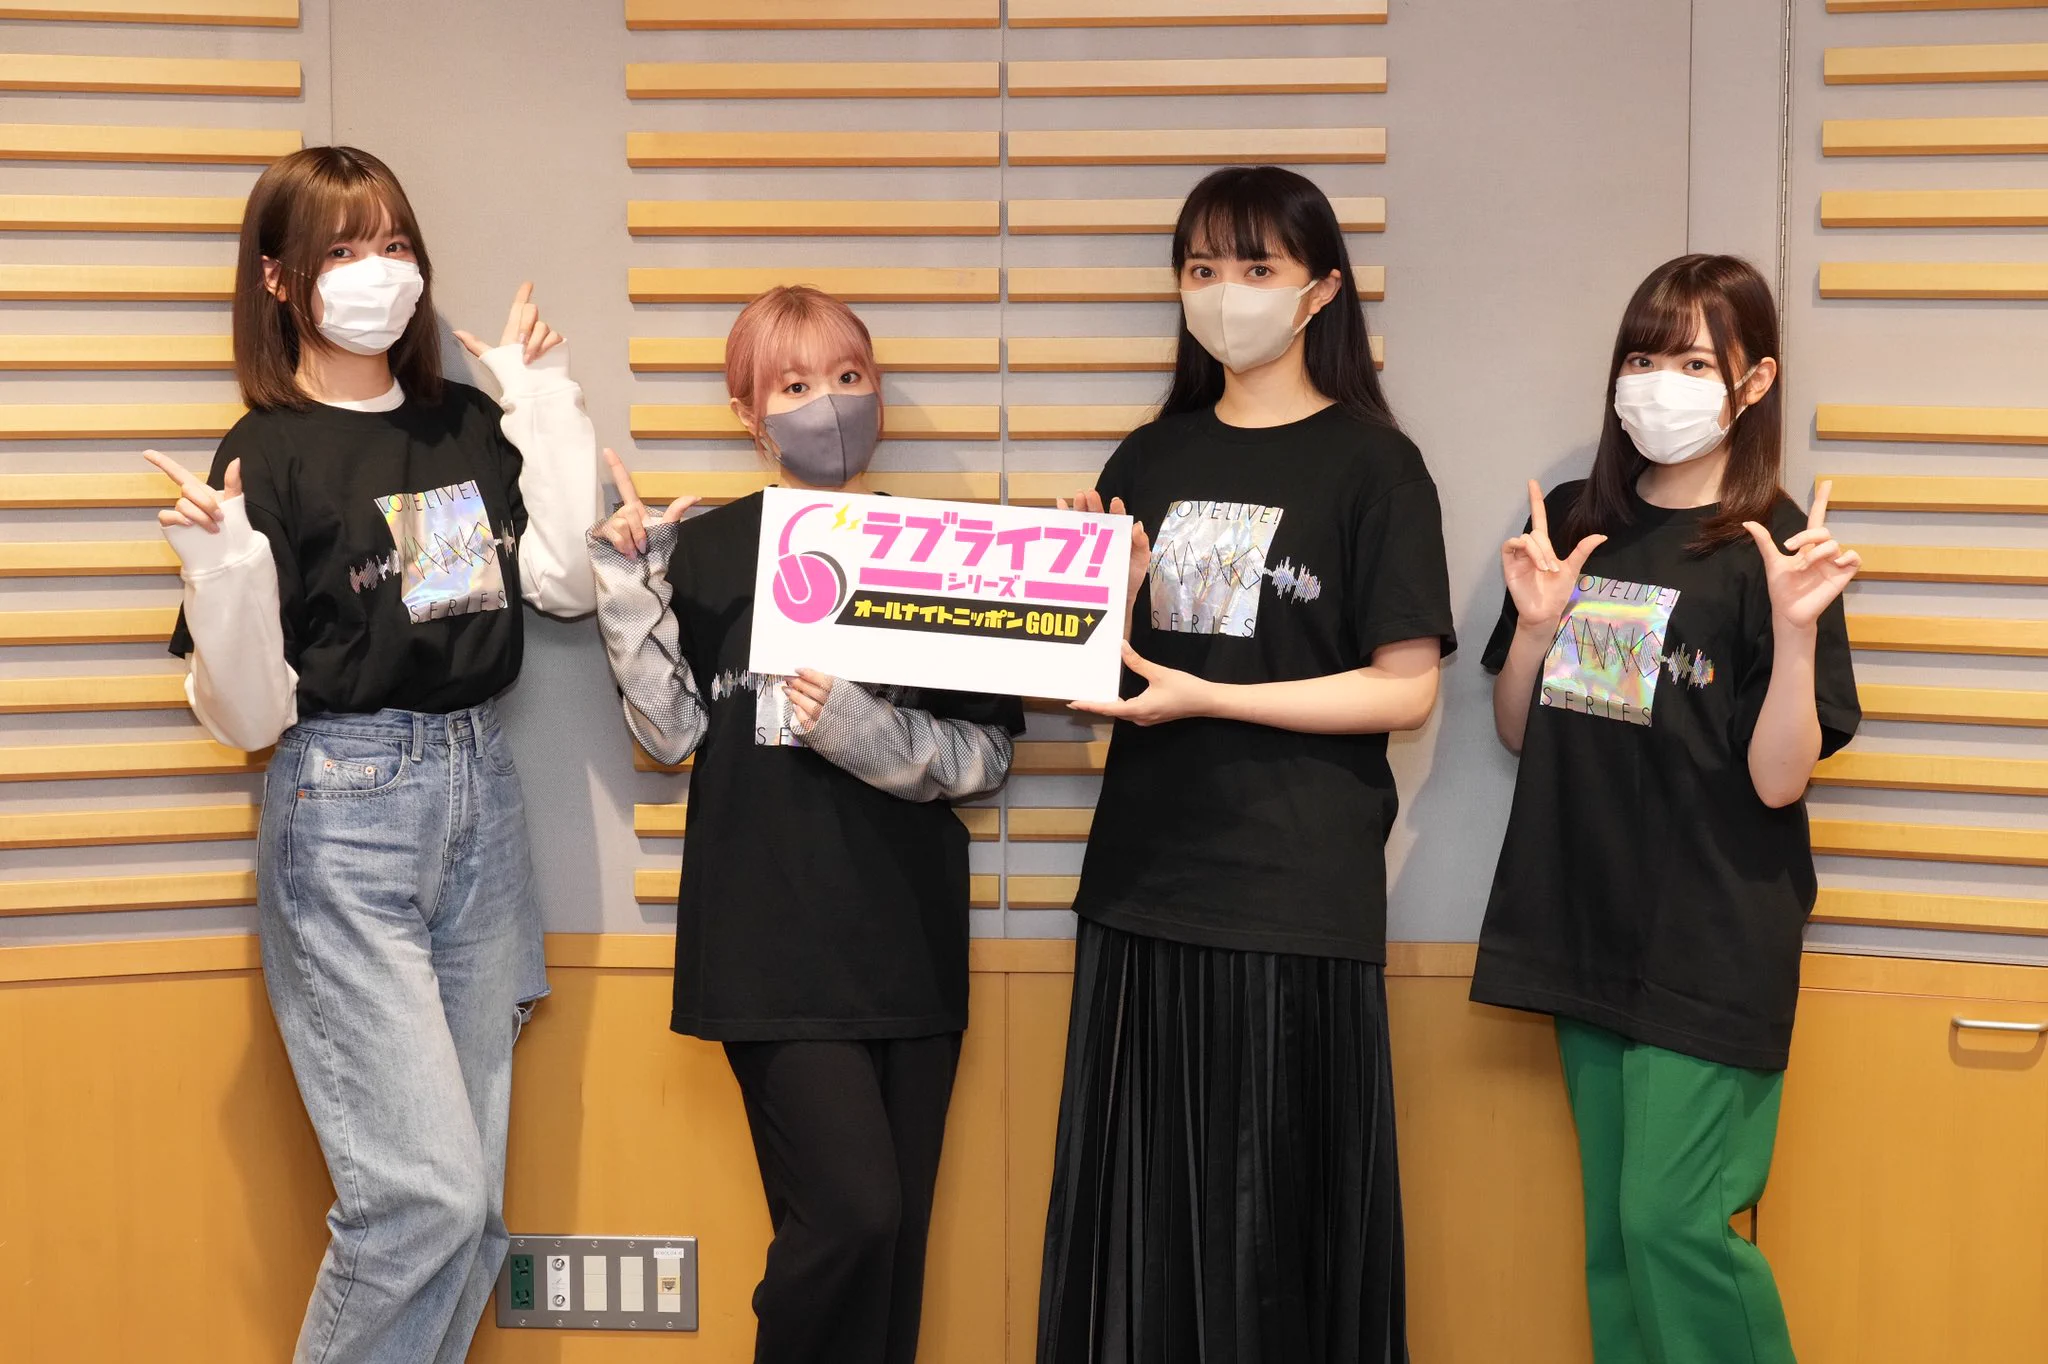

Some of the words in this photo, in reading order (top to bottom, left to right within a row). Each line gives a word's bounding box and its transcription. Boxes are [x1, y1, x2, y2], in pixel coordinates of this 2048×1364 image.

[862, 511, 1114, 578] ラブライブ!
[947, 572, 1021, 599] シリーズ
[1578, 574, 1681, 608] OVELIVE!
[409, 590, 506, 625] SERIES
[1152, 610, 1255, 639] SERIES
[1542, 686, 1652, 727] SERIES
